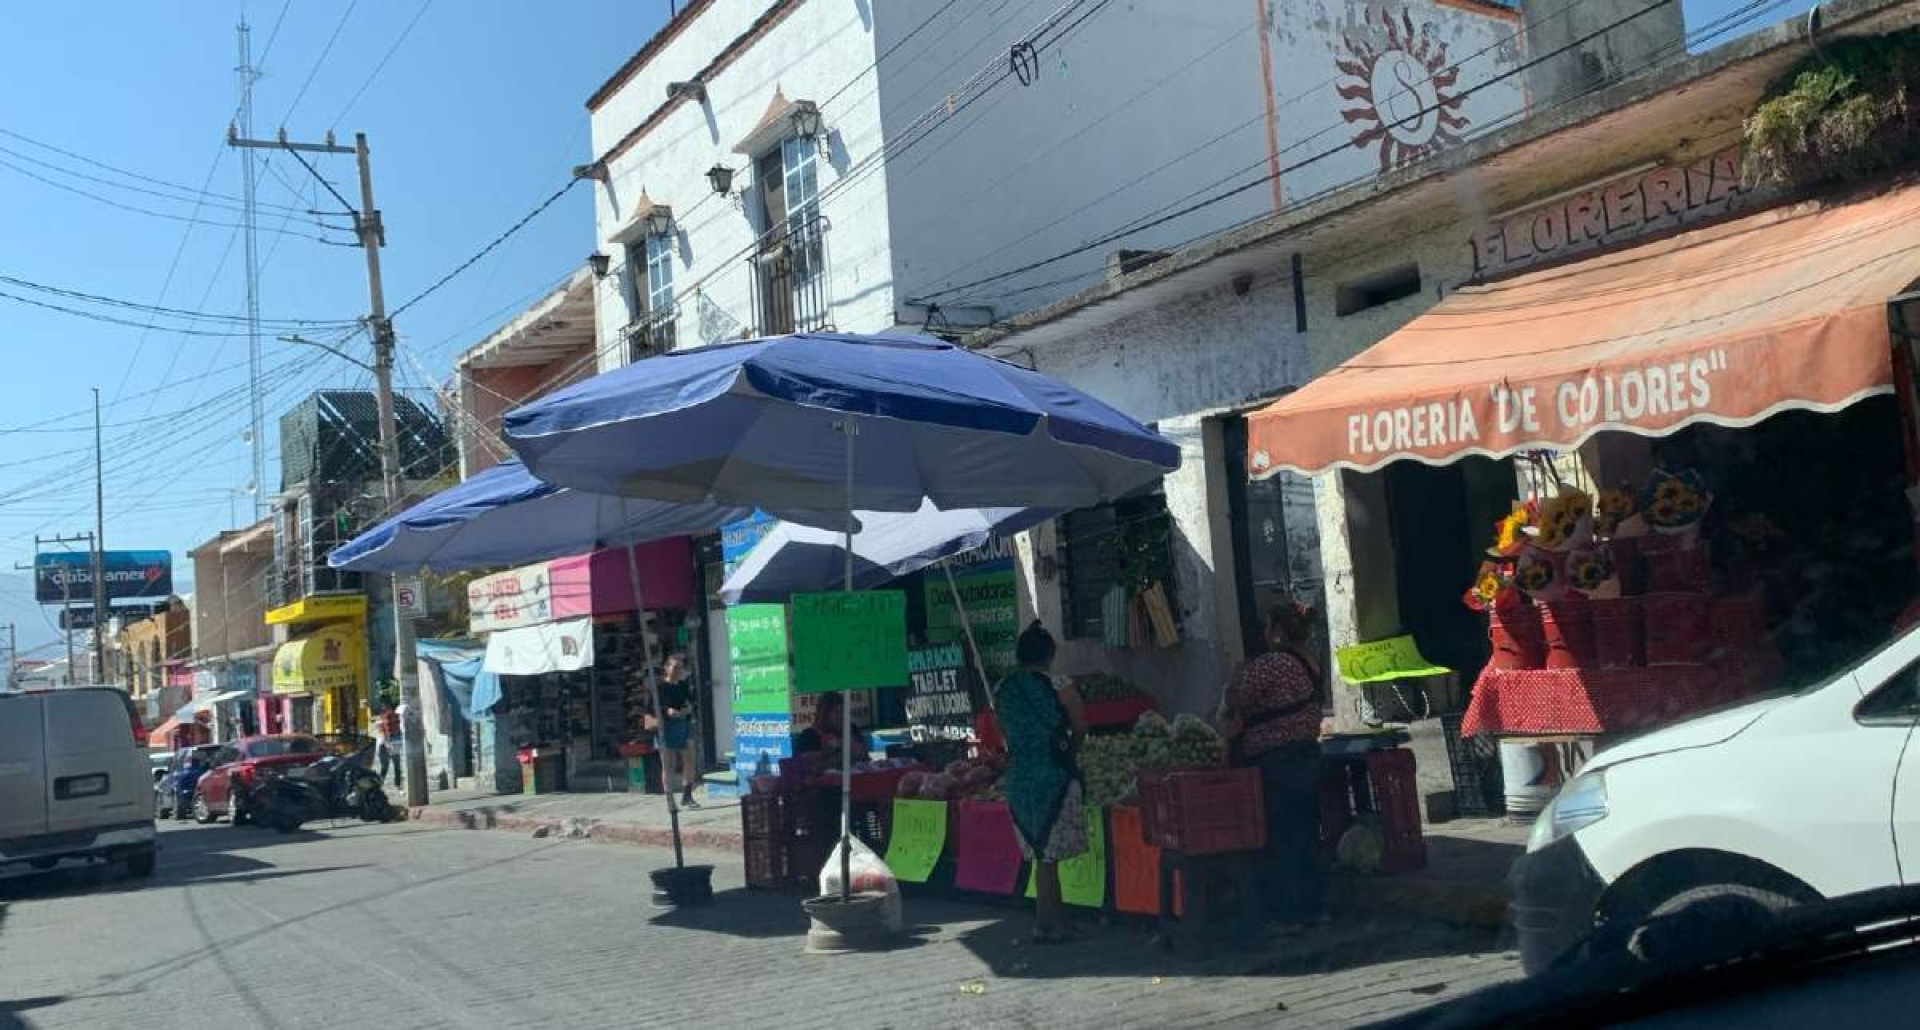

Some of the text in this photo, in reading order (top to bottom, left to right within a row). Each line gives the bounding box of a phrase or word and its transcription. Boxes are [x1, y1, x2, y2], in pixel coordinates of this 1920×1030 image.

[1469, 152, 1752, 273] FLORERIA
[1348, 396, 1480, 455] FLORERIA
[51, 568, 146, 585] citibaamex
[931, 582, 1015, 604] Comutadoras
[908, 641, 963, 672] EPARACIÓN
[912, 669, 957, 694] TABLET
[905, 691, 972, 719] COMPUTADORAS
